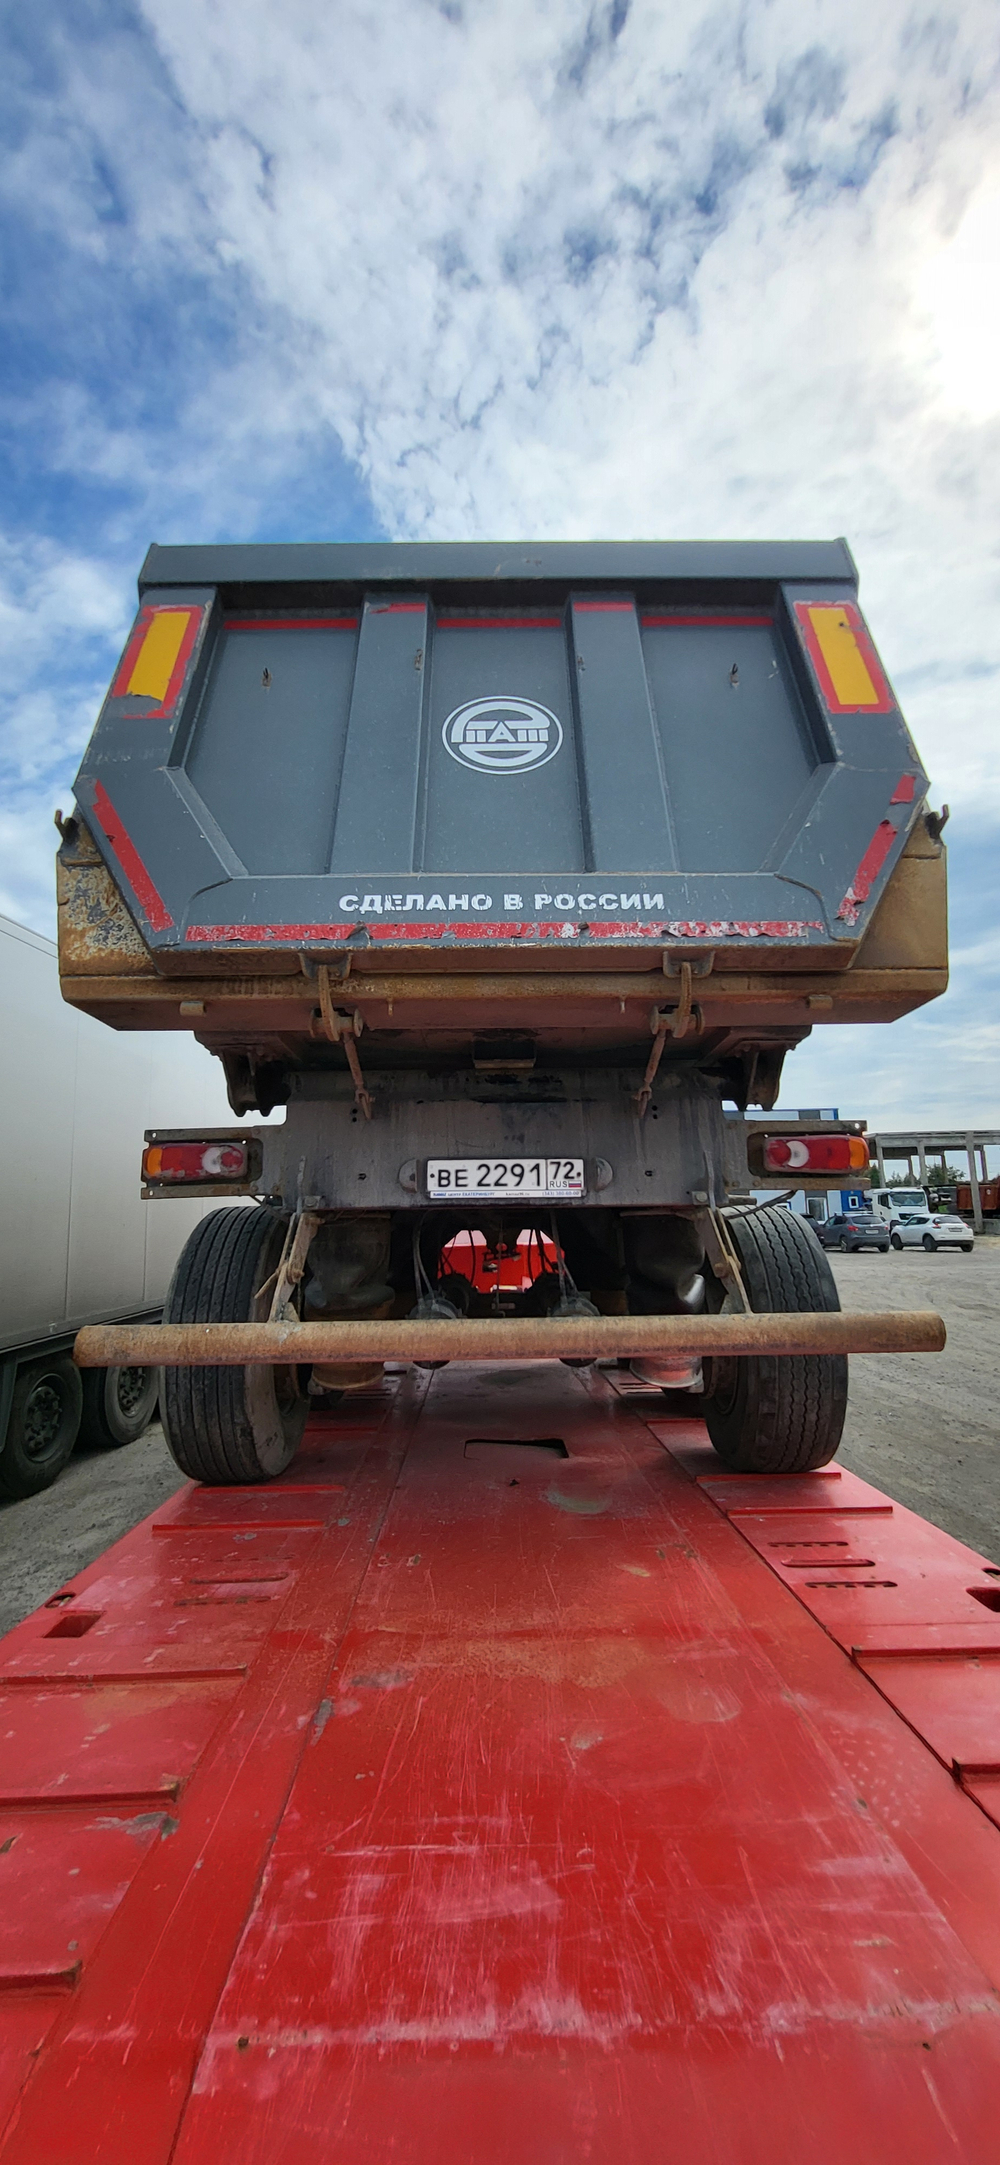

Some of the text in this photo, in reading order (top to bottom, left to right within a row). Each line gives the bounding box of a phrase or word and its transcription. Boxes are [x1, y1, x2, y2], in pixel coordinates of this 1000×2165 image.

[338, 892, 666, 915] СДЕЛАНО В РОССИИ
[476, 1162, 542, 1188] 2291
[549, 1160, 576, 1181] 72
[549, 1180, 568, 1188] RUS
